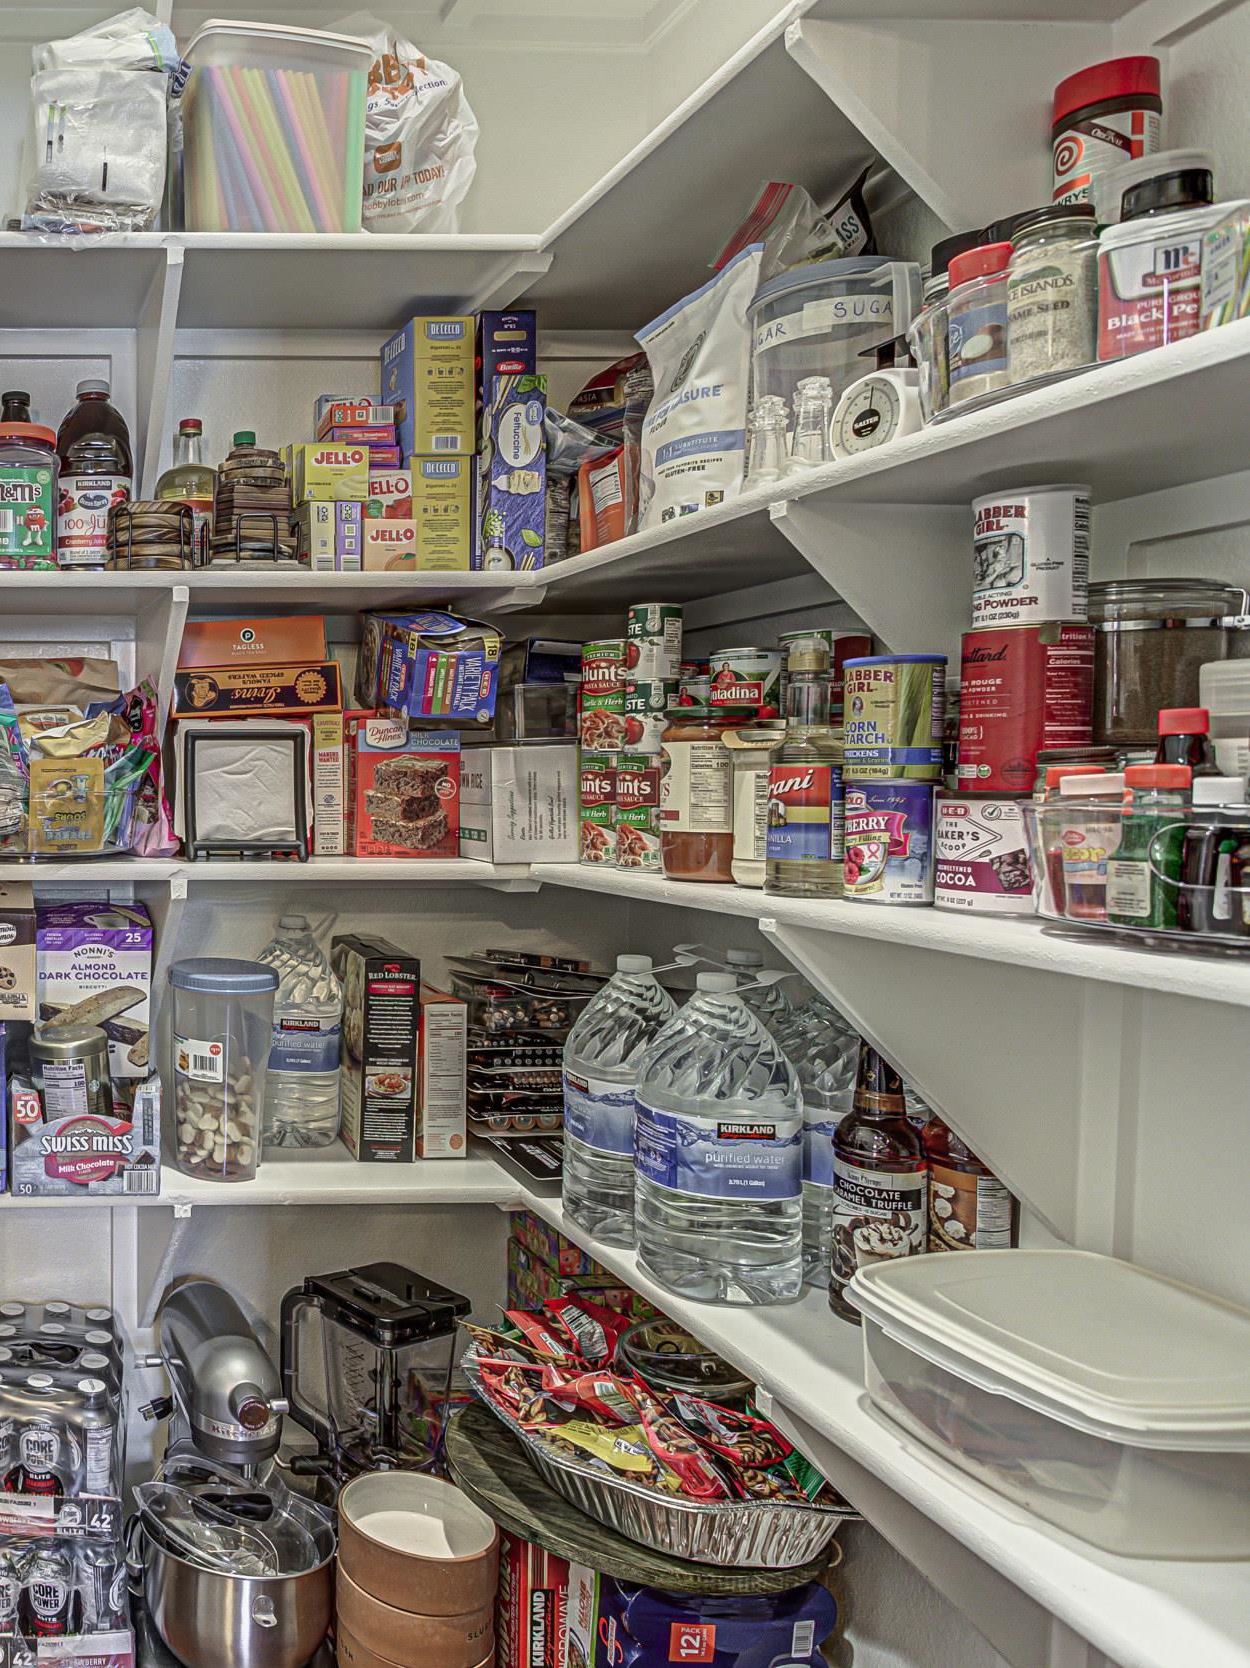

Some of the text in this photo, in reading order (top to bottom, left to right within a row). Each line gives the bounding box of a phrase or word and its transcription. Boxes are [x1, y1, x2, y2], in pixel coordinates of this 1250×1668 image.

[1091, 128, 1124, 148] ORIGINAL
[377, 165, 445, 193] OUR TODAY!
[1037, 300, 1071, 314] SEED
[1107, 307, 1165, 331] Black
[853, 415, 880, 429] SALTER
[513, 411, 522, 461] Fettuccine
[664, 464, 706, 479] GLUTEN-FREE
[975, 519, 1006, 536] GIRL
[65, 537, 93, 546] Cranberry
[988, 590, 1013, 598] ACTING
[983, 596, 1039, 611] POWDER
[409, 637, 417, 651] 18
[487, 644, 498, 657] 18
[453, 664, 465, 706] INSTANT OATMEAL
[458, 656, 481, 712] VARIETY PACK
[847, 682, 874, 694] GIRL
[971, 678, 1003, 686] ROUGE
[604, 698, 623, 706] Herb
[845, 720, 877, 733] CORN
[373, 732, 403, 744] Hines
[411, 738, 459, 746] CHOCOLATE
[471, 773, 483, 789] RICE
[54, 811, 87, 822] SOURS
[628, 813, 646, 821] Herb
[946, 821, 958, 829] THE
[858, 834, 882, 843] Filling
[940, 842, 967, 852] SCOOP
[936, 871, 977, 887] COCOA
[125, 932, 142, 943] 25
[73, 947, 115, 959] NONNI'S
[70, 963, 116, 971] ALMOND
[39, 971, 148, 980] DARK CHOCOLATE
[368, 971, 417, 981] RED LOBSTER
[282, 1019, 319, 1027] KIRKLAND
[272, 1040, 302, 1048] purified
[15, 1100, 39, 1118] 50
[720, 1124, 774, 1134] KIRKLAND
[705, 1152, 784, 1165] purified water
[58, 1159, 115, 1174] Milk Chocolate
[19, 1184, 32, 1193] 50
[839, 1179, 901, 1201] CHOCOLATE
[871, 1199, 914, 1210] TRUFFLE
[25, 1439, 54, 1454] CORE
[32, 1583, 59, 1598] CORE
[33, 1598, 60, 1609] POWER
[37, 1614, 57, 1622] ELITE
[532, 1591, 545, 1667] KIRKLAND
[679, 1634, 702, 1657] 12
